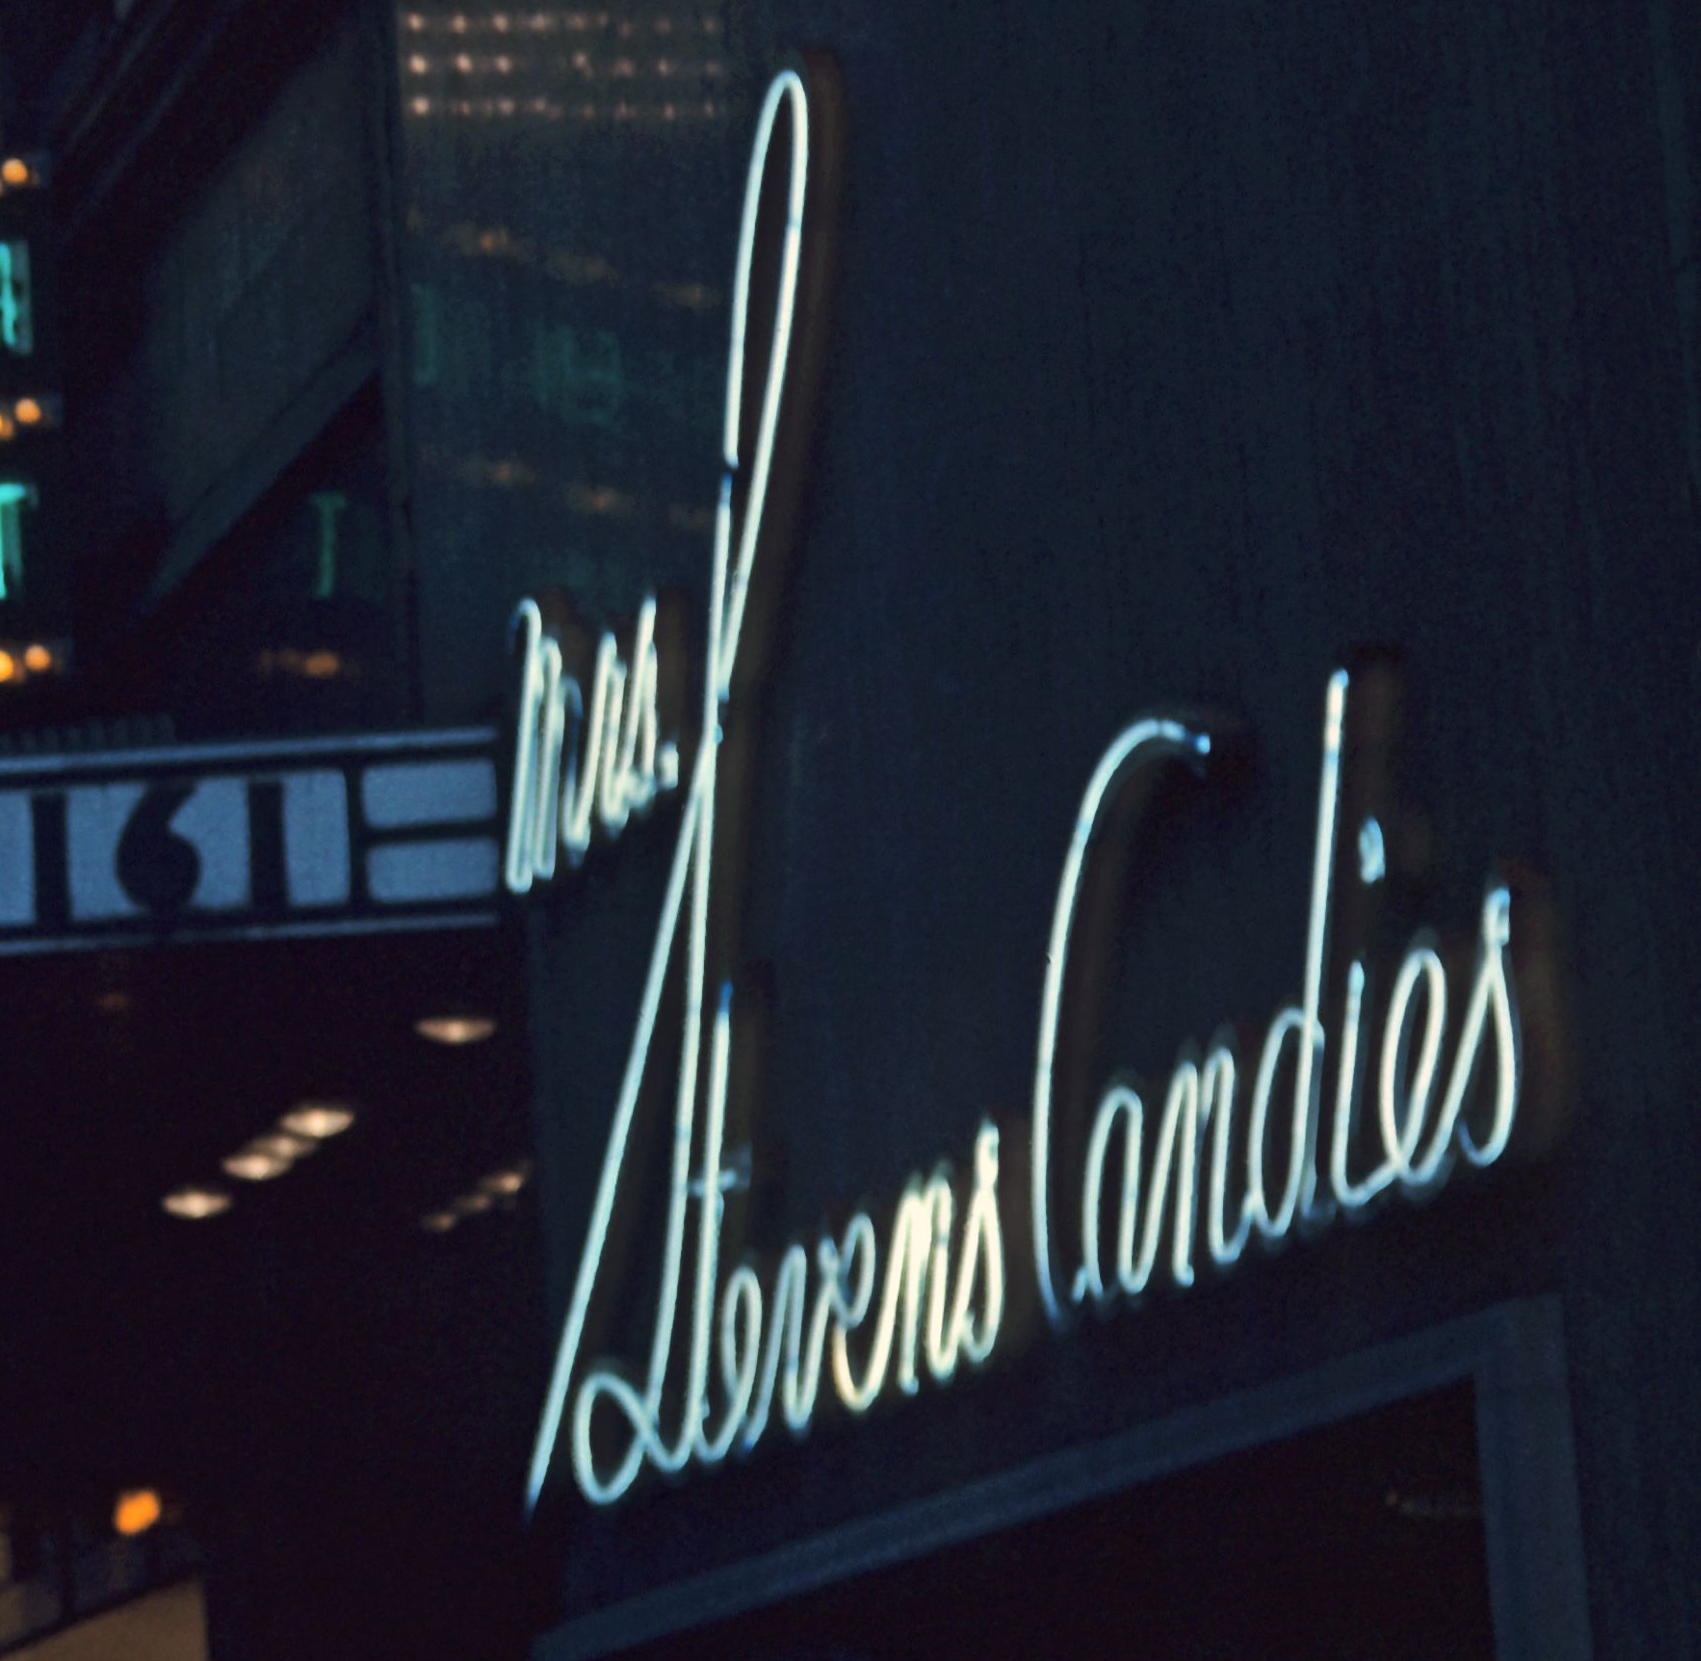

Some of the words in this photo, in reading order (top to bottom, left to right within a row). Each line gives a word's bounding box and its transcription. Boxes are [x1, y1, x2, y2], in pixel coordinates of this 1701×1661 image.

[31, 776, 289, 928] 161
[525, 68, 1005, 1522] Stevens
[1033, 668, 1521, 1334] Candies
